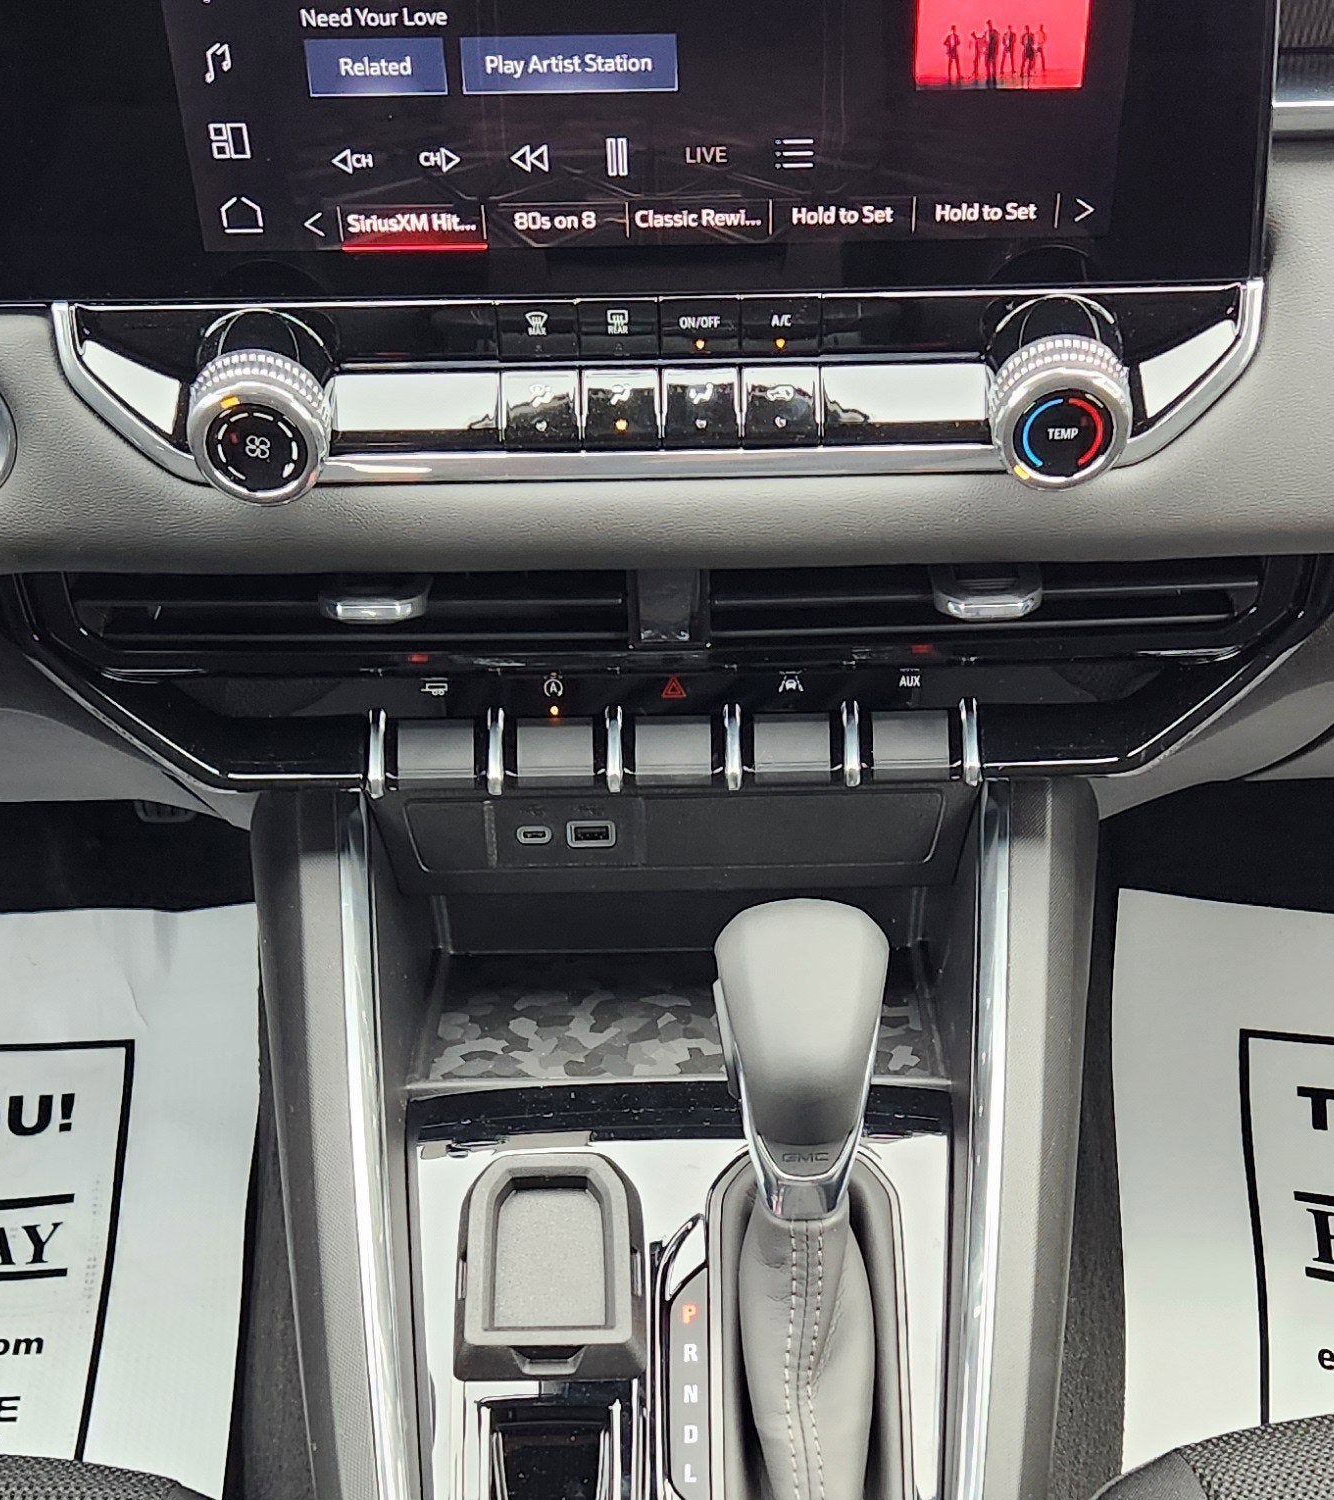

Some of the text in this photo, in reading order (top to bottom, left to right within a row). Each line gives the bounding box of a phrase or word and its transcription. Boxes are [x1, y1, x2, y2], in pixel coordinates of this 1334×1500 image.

[299, 8, 448, 28] Need Your Love
[339, 56, 412, 77] Related
[485, 53, 653, 79] Play Artist Station
[352, 153, 374, 169] CH
[419, 151, 442, 167] CH
[685, 146, 728, 165] LIVE
[514, 211, 597, 230] 80s on 8
[634, 209, 698, 229] Classic
[791, 206, 894, 227] Hold to Set
[934, 202, 1037, 223] Hold to Set
[346, 212, 478, 233] SiriusXM Hit...
[607, 325, 629, 335] REAR
[679, 316, 720, 330] ON/OFF
[771, 314, 791, 327] A/C
[1047, 428, 1078, 440] TEMP
[899, 675, 921, 688] AUX
[782, 1152, 829, 1163] GMC
[682, 1304, 699, 1484] P R N D L
